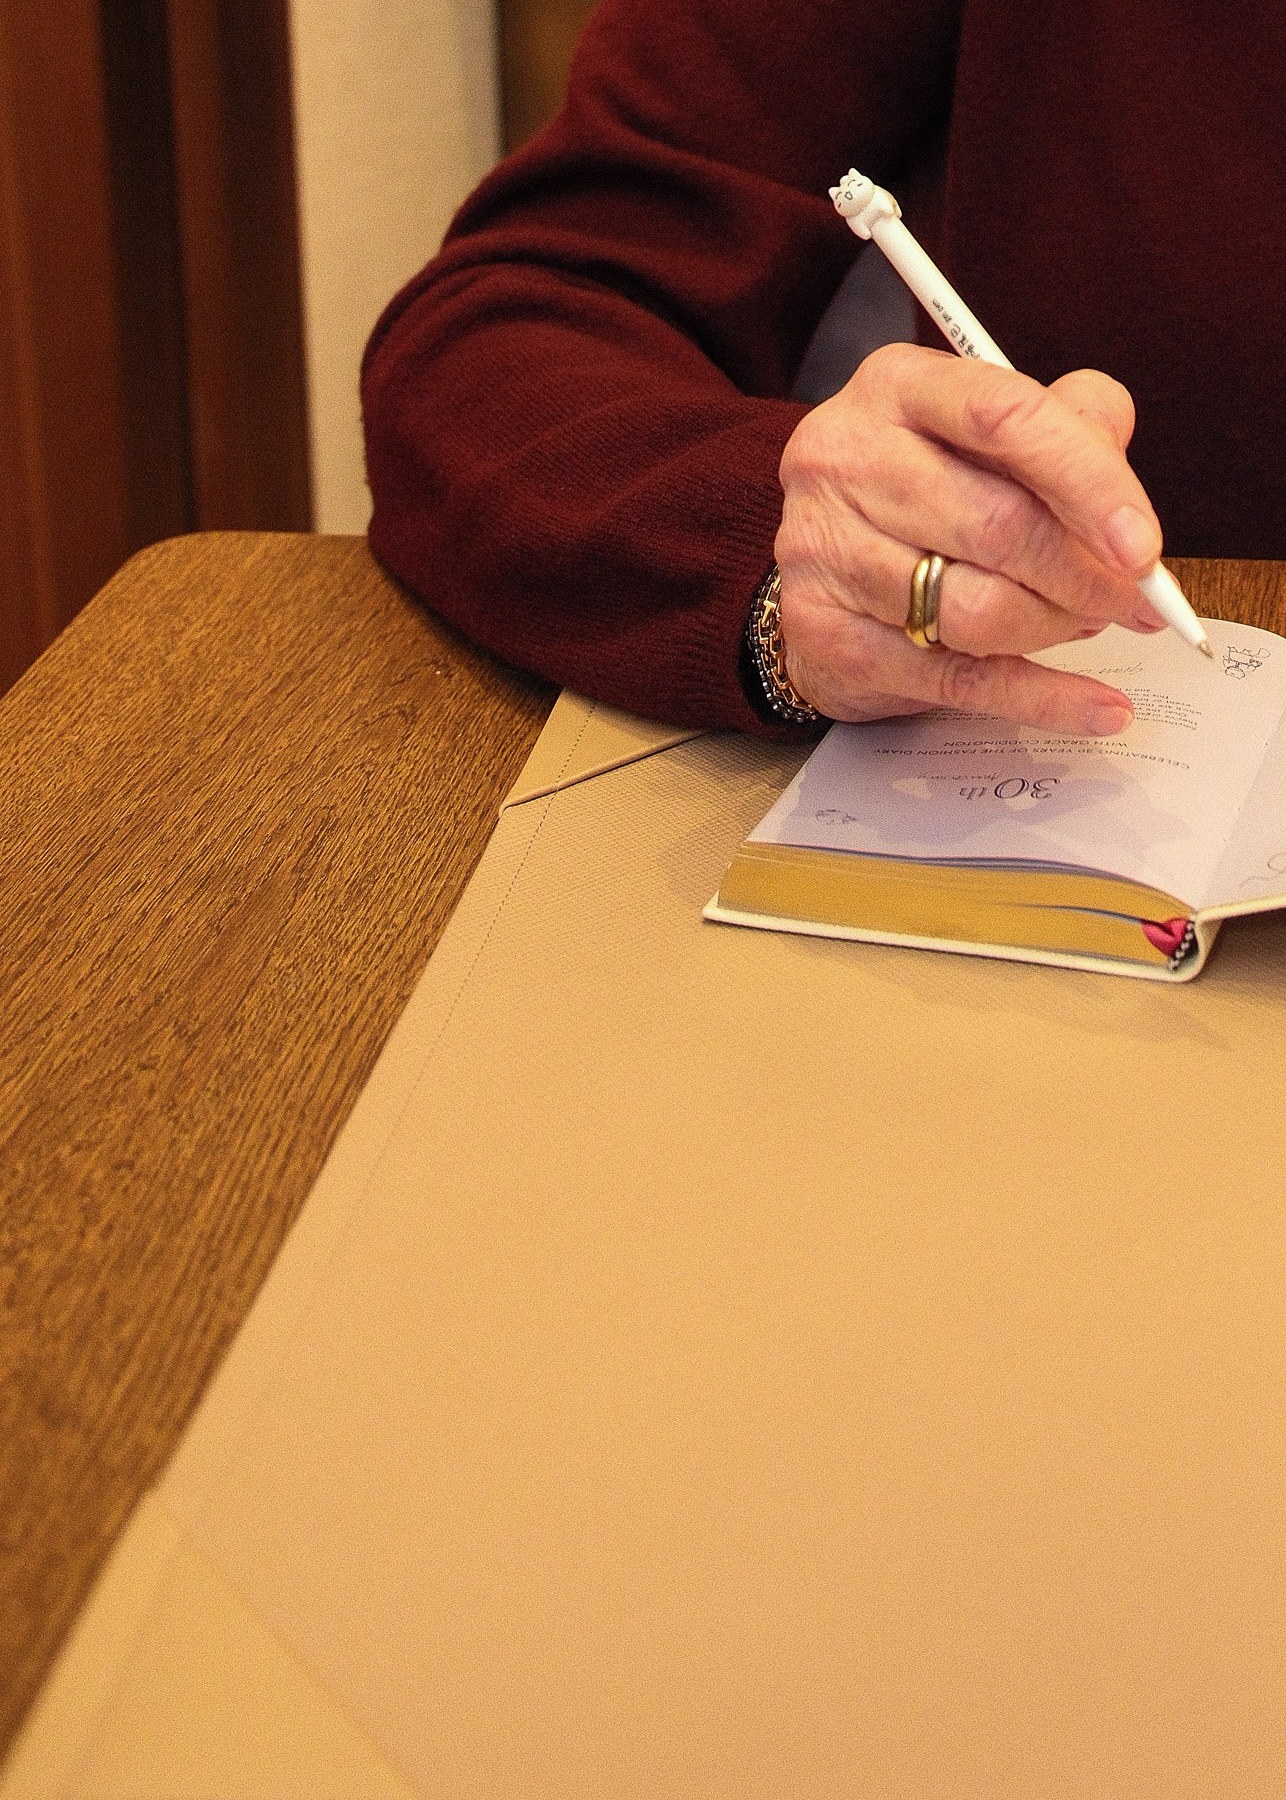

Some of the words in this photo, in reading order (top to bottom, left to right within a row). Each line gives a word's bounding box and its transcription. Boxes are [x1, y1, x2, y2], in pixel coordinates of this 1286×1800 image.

[943, 738, 1041, 747] CODDINGTON
[1044, 739, 1089, 747] GRACE
[1092, 739, 1128, 748] WITH
[872, 746, 914, 756] DIARY
[916, 747, 977, 756] FASHION
[981, 747, 1007, 755] THE
[1008, 747, 1028, 755] OF
[1032, 747, 1073, 755] YEARS
[1077, 747, 1094, 755] 30
[1097, 747, 1191, 770] CELEBRATING
